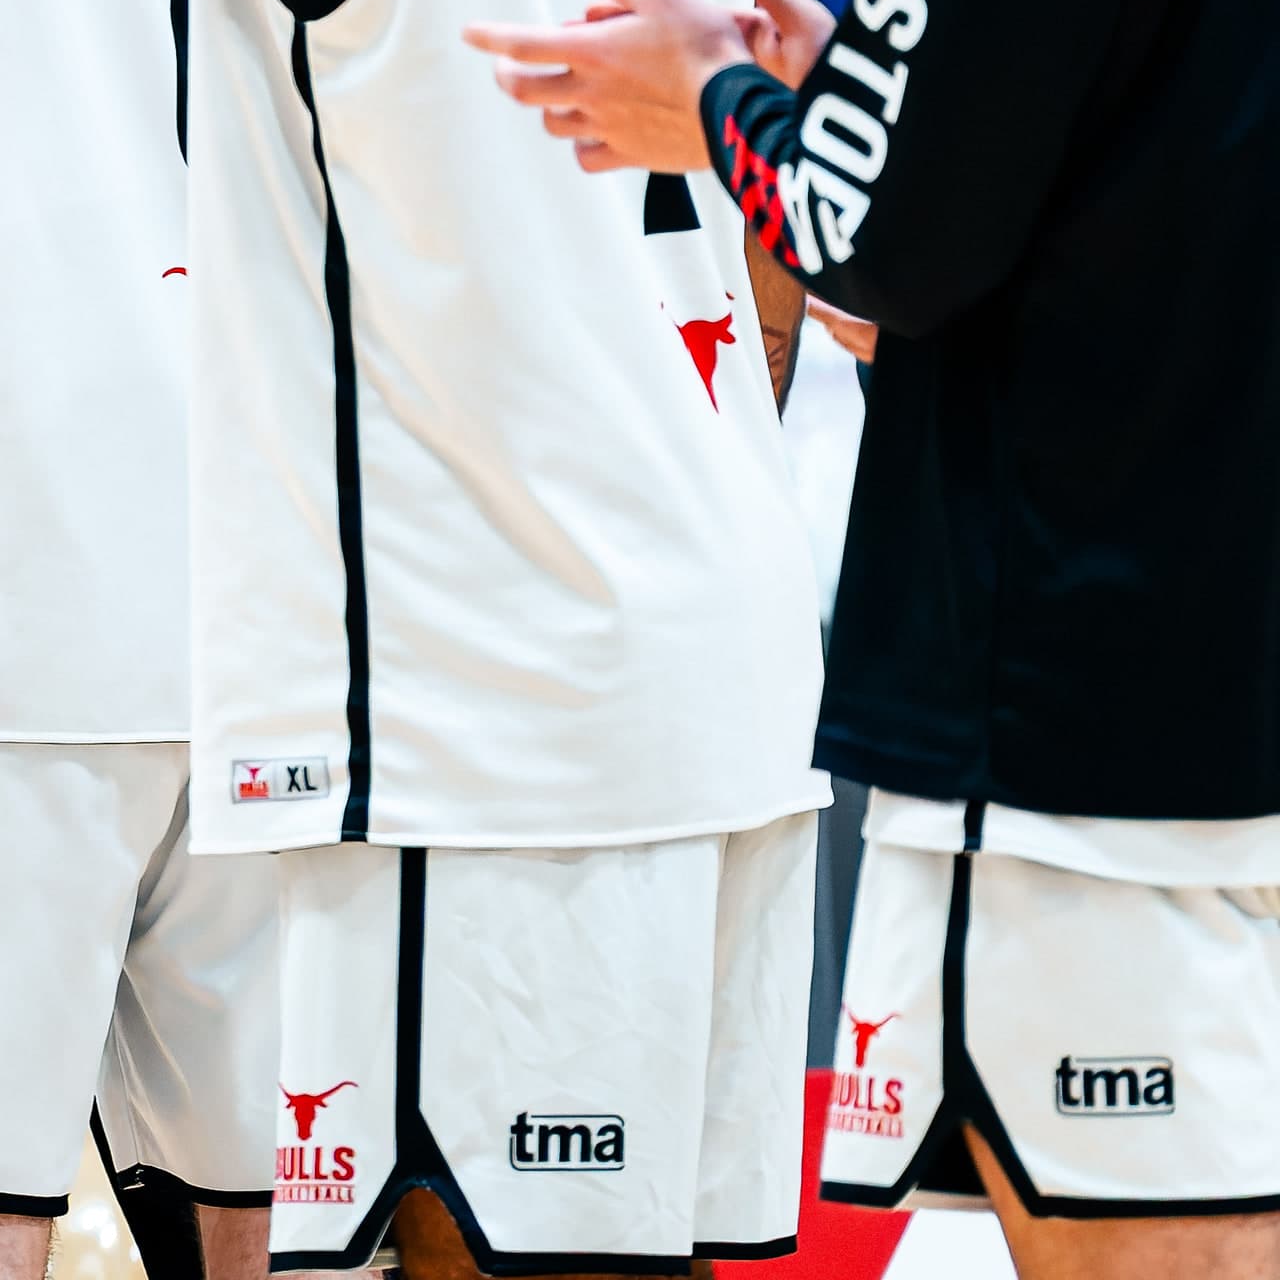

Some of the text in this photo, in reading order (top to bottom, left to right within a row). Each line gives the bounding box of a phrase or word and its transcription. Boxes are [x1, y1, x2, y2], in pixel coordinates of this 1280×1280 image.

[287, 765, 318, 792] XL
[1055, 1055, 1175, 1107] tma
[510, 1111, 624, 1163] tma
